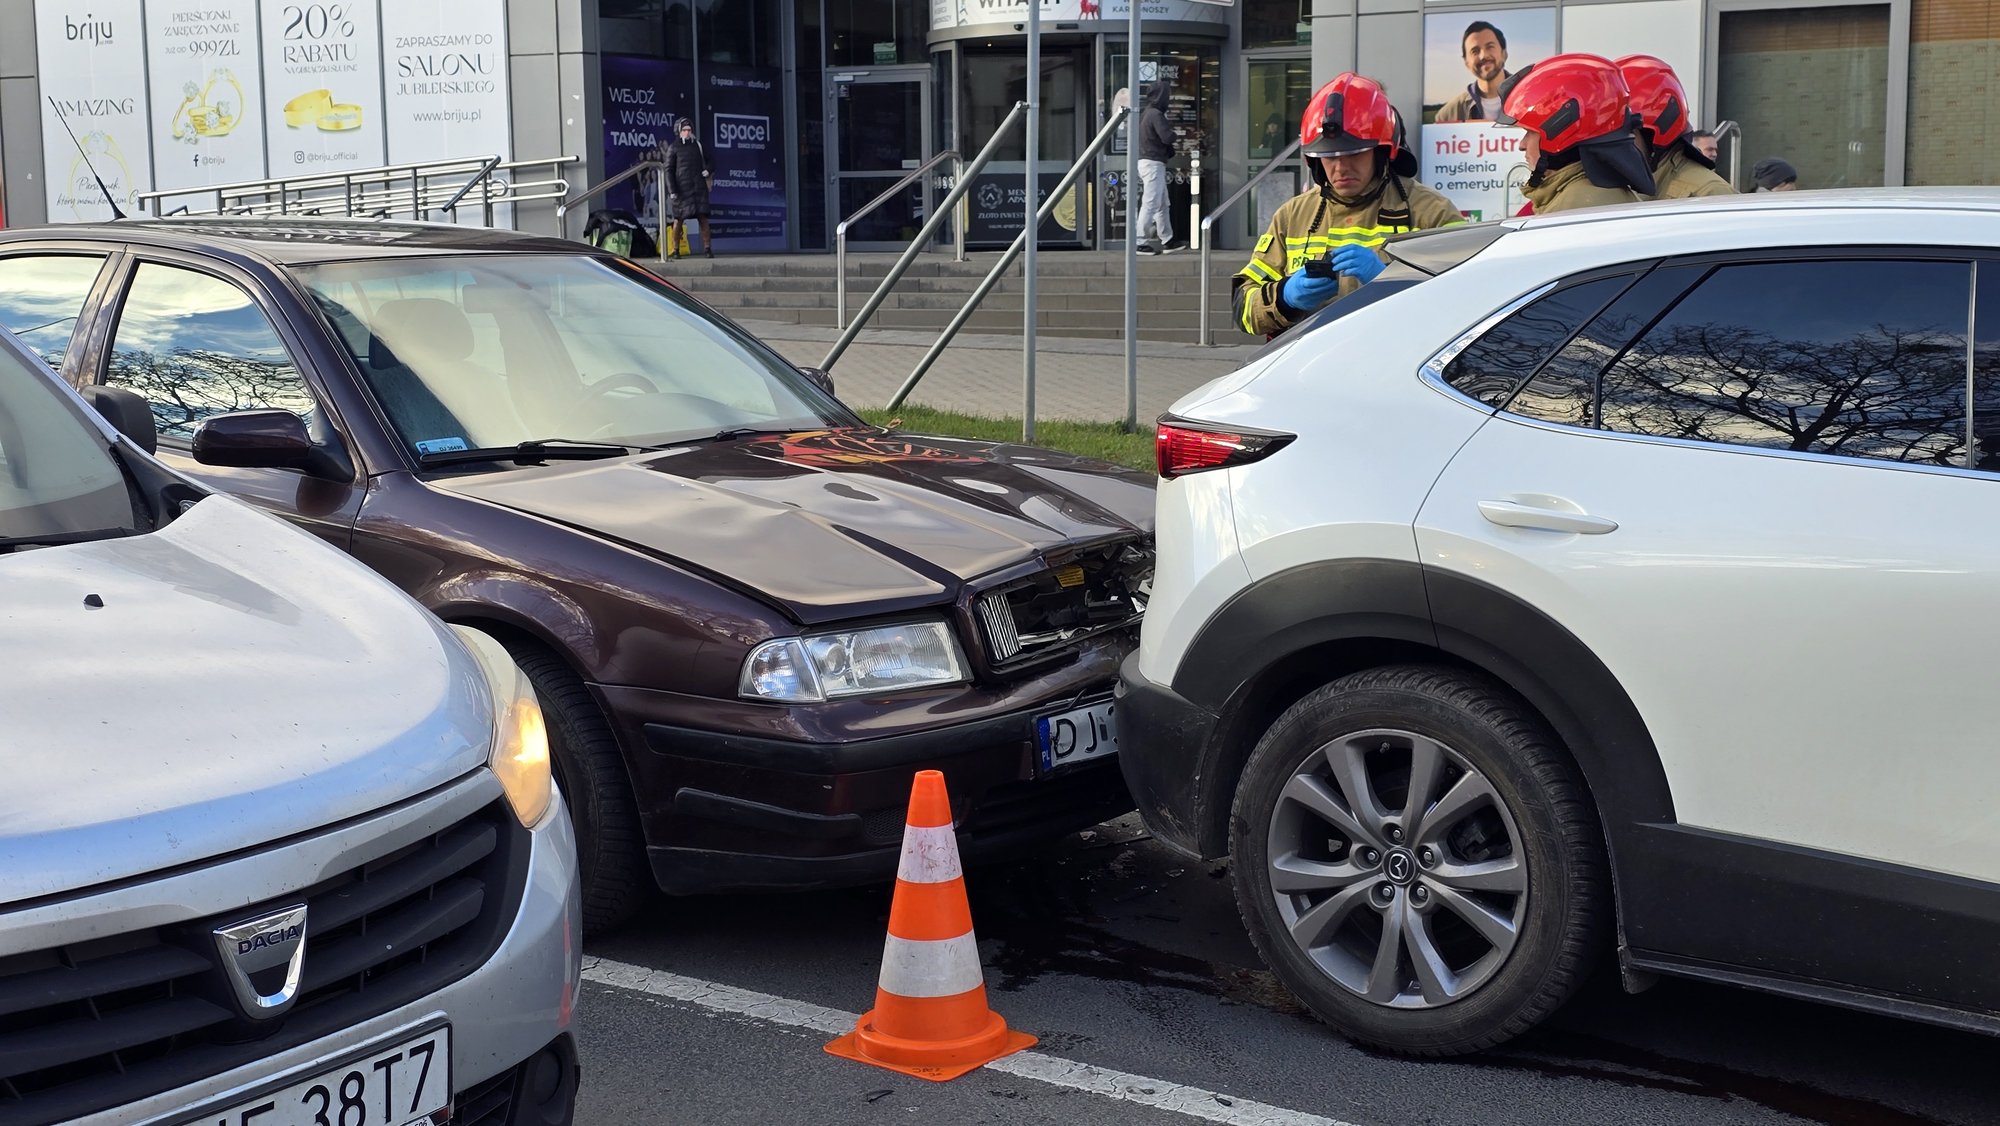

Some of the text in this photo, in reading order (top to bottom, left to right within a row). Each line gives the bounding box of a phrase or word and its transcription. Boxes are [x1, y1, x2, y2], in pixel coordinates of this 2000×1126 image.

[1112, 5, 1169, 14] KARNOSZY
[65, 13, 113, 47] briju
[283, 3, 355, 41] 20%
[396, 33, 493, 48] ZAPRASZAMY DO
[283, 43, 358, 63] RABATU
[397, 52, 495, 78] SALONU
[396, 80, 495, 96] JUBILERSKIEGO
[608, 86, 656, 105] WEJDŹ
[54, 98, 134, 117] AMAZING
[413, 108, 481, 123] www.briju.pl
[620, 108, 675, 127] W ŚWIAT
[610, 128, 657, 148] TAŃCA
[720, 123, 765, 141] space
[1435, 133, 1519, 158] nie jutr
[1435, 160, 1497, 176] myślenia
[1435, 181, 1443, 191] o
[1042, 750, 1051, 763] PL
[238, 925, 299, 955] DACIA
